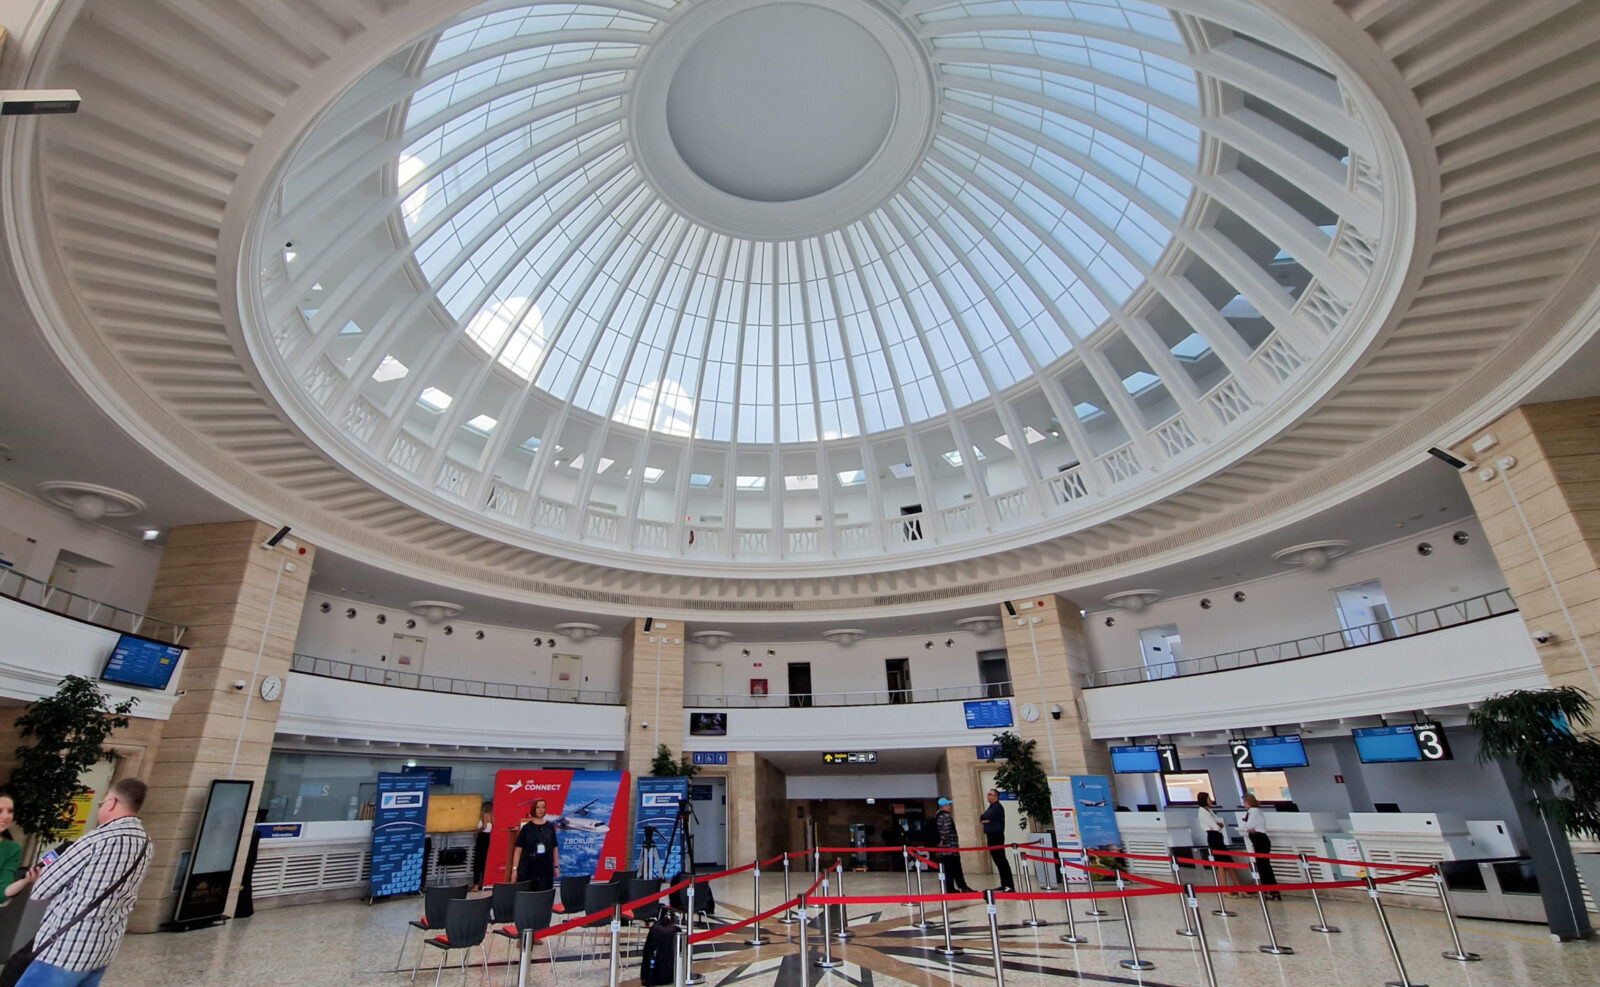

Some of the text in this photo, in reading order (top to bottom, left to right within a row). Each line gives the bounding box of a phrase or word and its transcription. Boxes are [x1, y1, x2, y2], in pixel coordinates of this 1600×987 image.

[1419, 730, 1443, 759] 3
[1163, 750, 1174, 771] 1
[1233, 745, 1252, 768] 2
[524, 783, 562, 791] CONNECT
